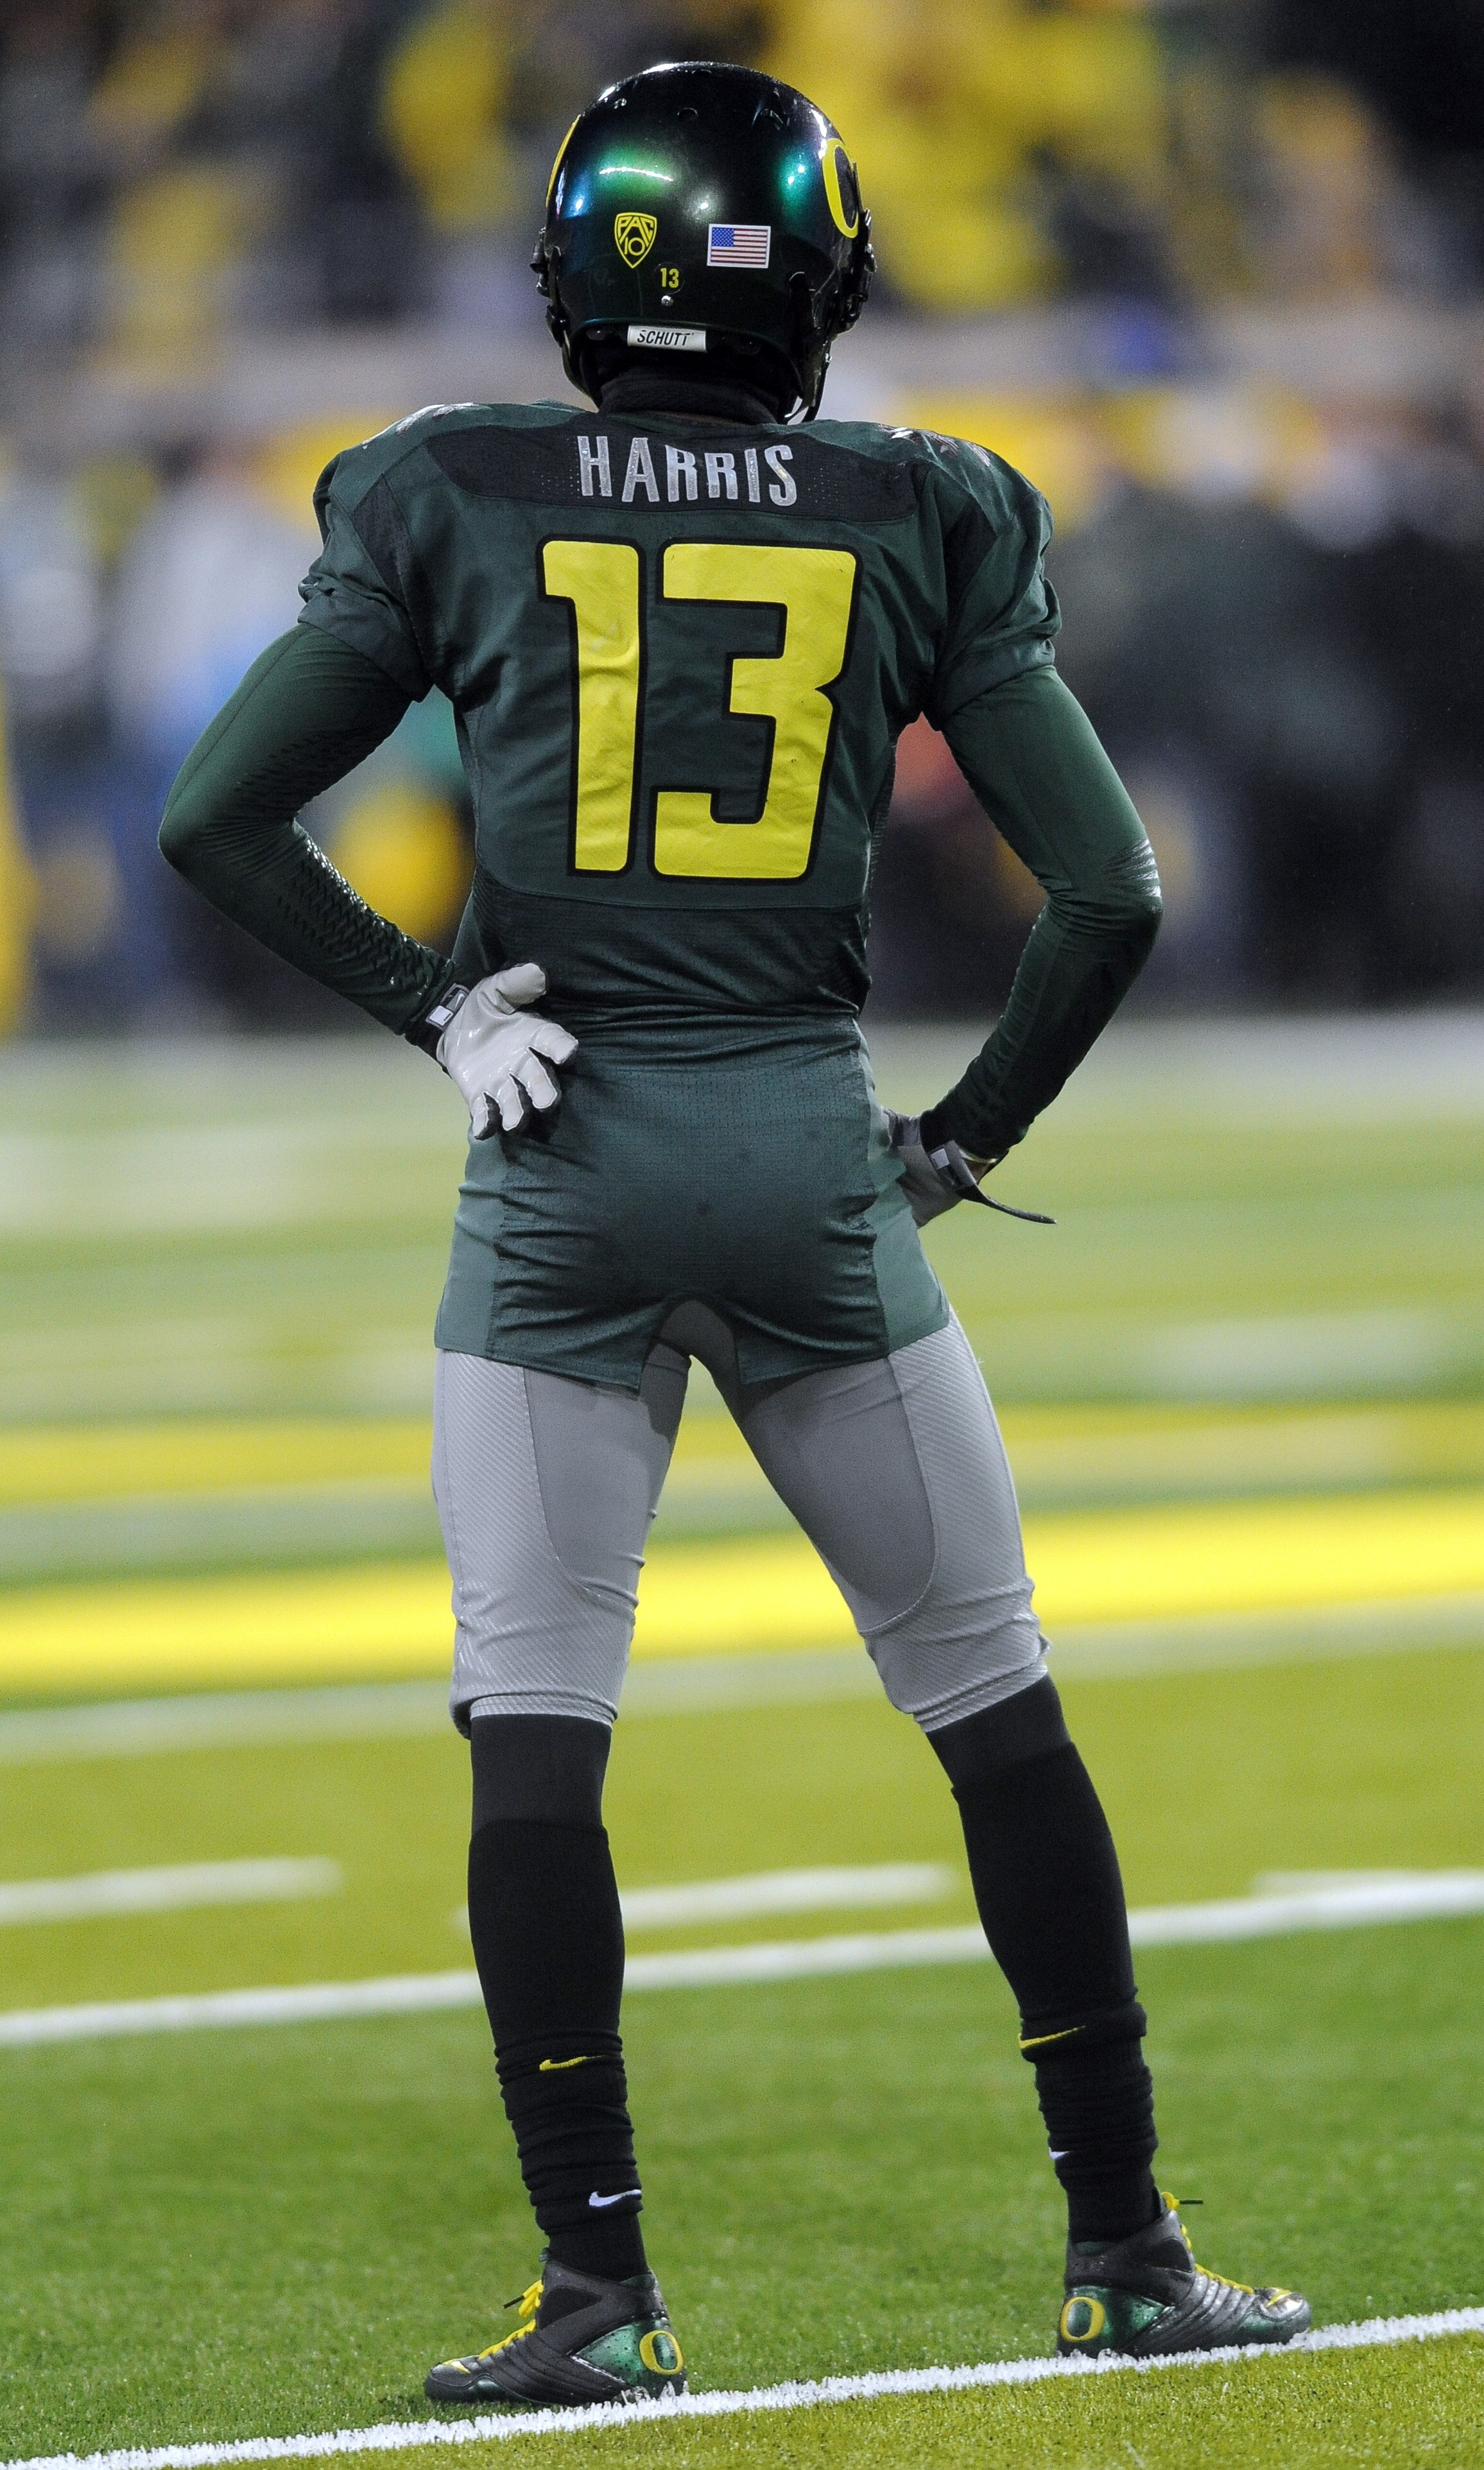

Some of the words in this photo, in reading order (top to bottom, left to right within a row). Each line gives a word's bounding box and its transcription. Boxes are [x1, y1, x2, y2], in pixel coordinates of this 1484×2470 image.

[619, 216, 653, 247] PAC
[624, 236, 646, 256] 10
[660, 267, 679, 288] 13
[637, 329, 691, 346] SCHUTT
[577, 435, 797, 506] HARRIS
[542, 540, 858, 879] 13
[1060, 2296, 1105, 2342] O
[639, 2329, 685, 2375] O
